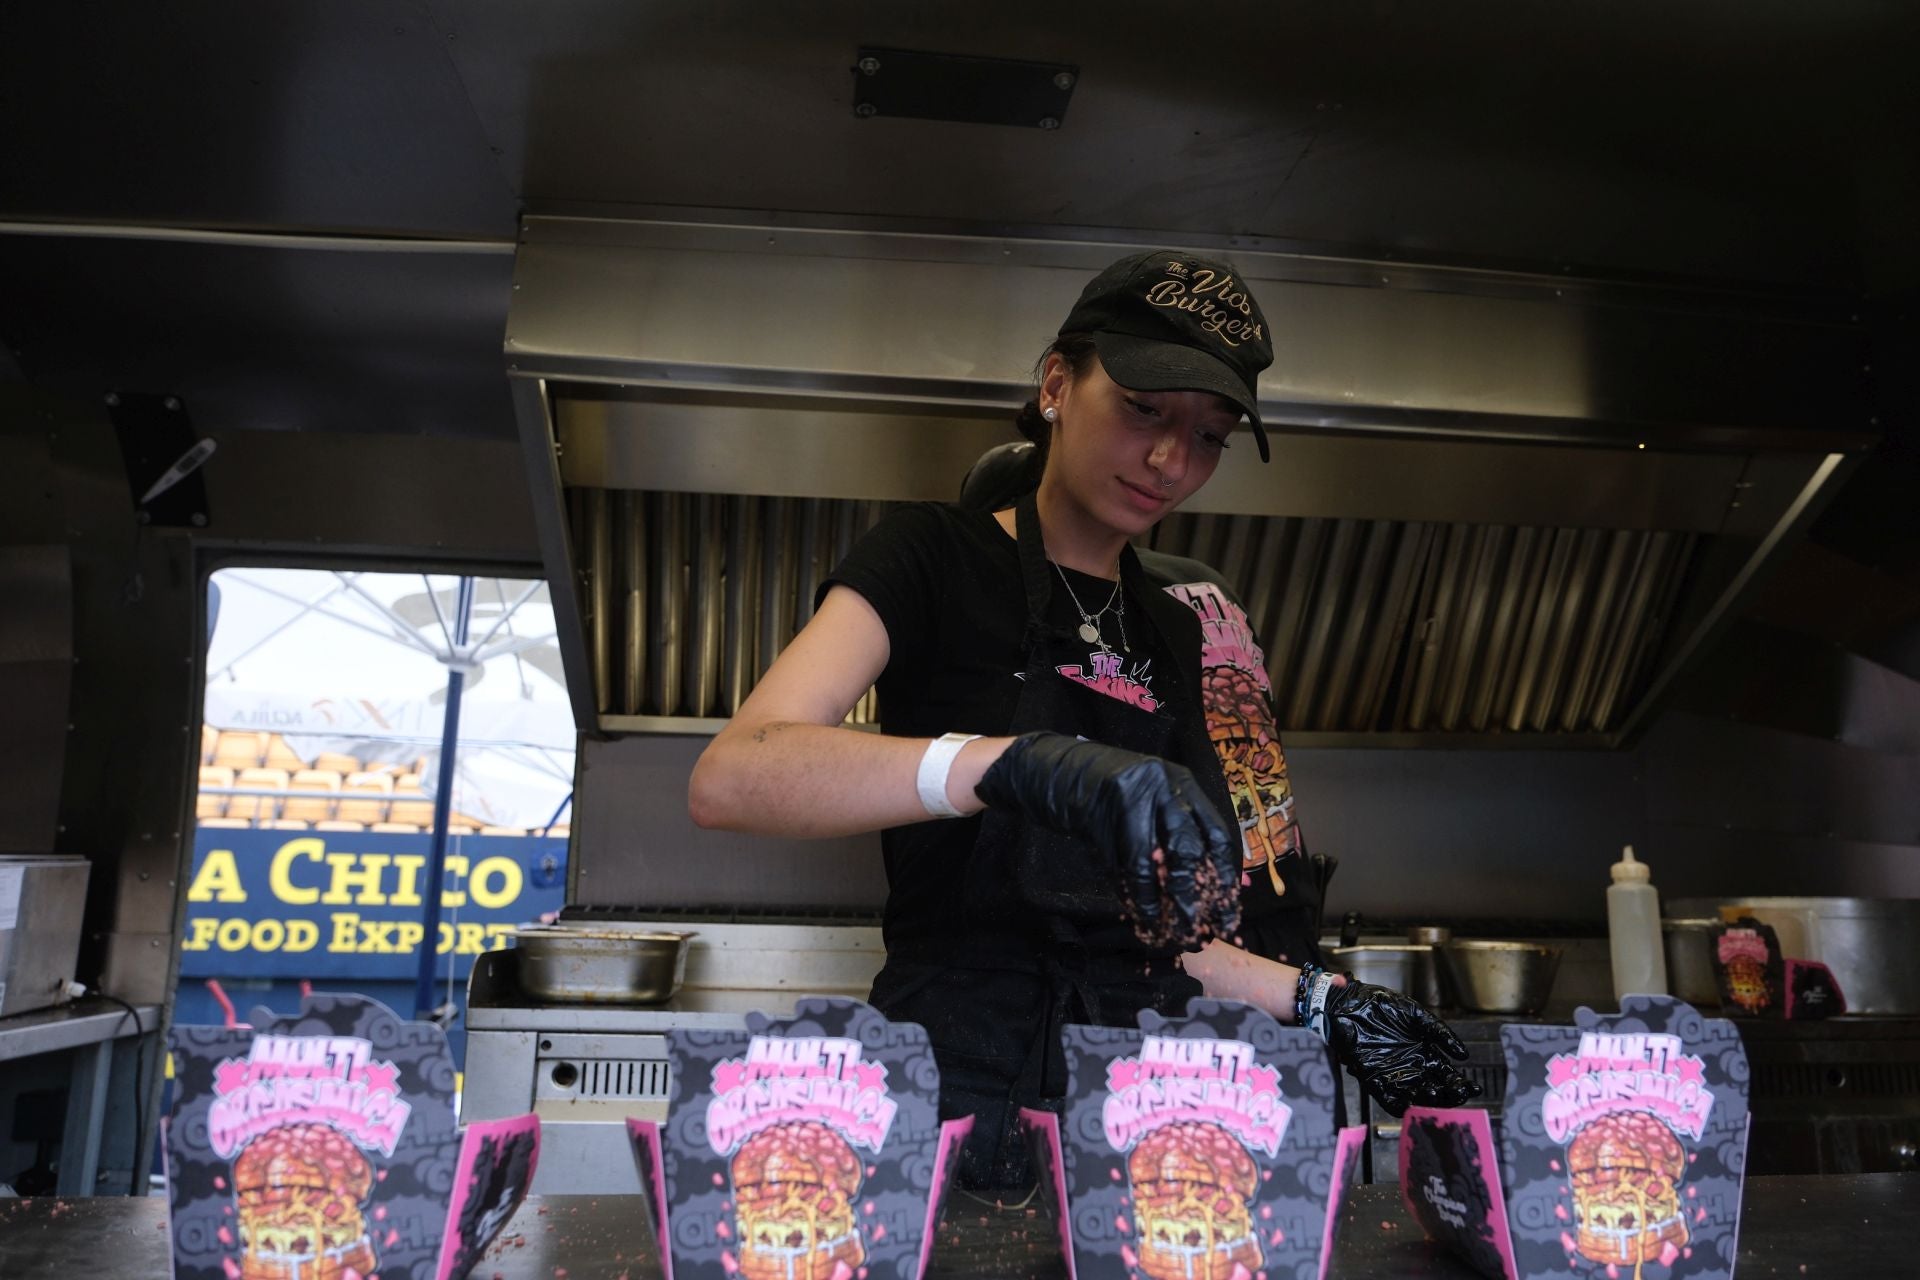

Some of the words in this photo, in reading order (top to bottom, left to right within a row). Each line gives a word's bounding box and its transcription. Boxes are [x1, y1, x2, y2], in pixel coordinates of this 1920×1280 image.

[1167, 261, 1189, 275] The
[1092, 654, 1121, 677] THE
[188, 850, 247, 903] A
[249, 1035, 373, 1083] MULTI
[744, 1035, 862, 1082] MULTI
[1137, 1035, 1255, 1085] MULTI
[1577, 1032, 1682, 1078] MULTI
